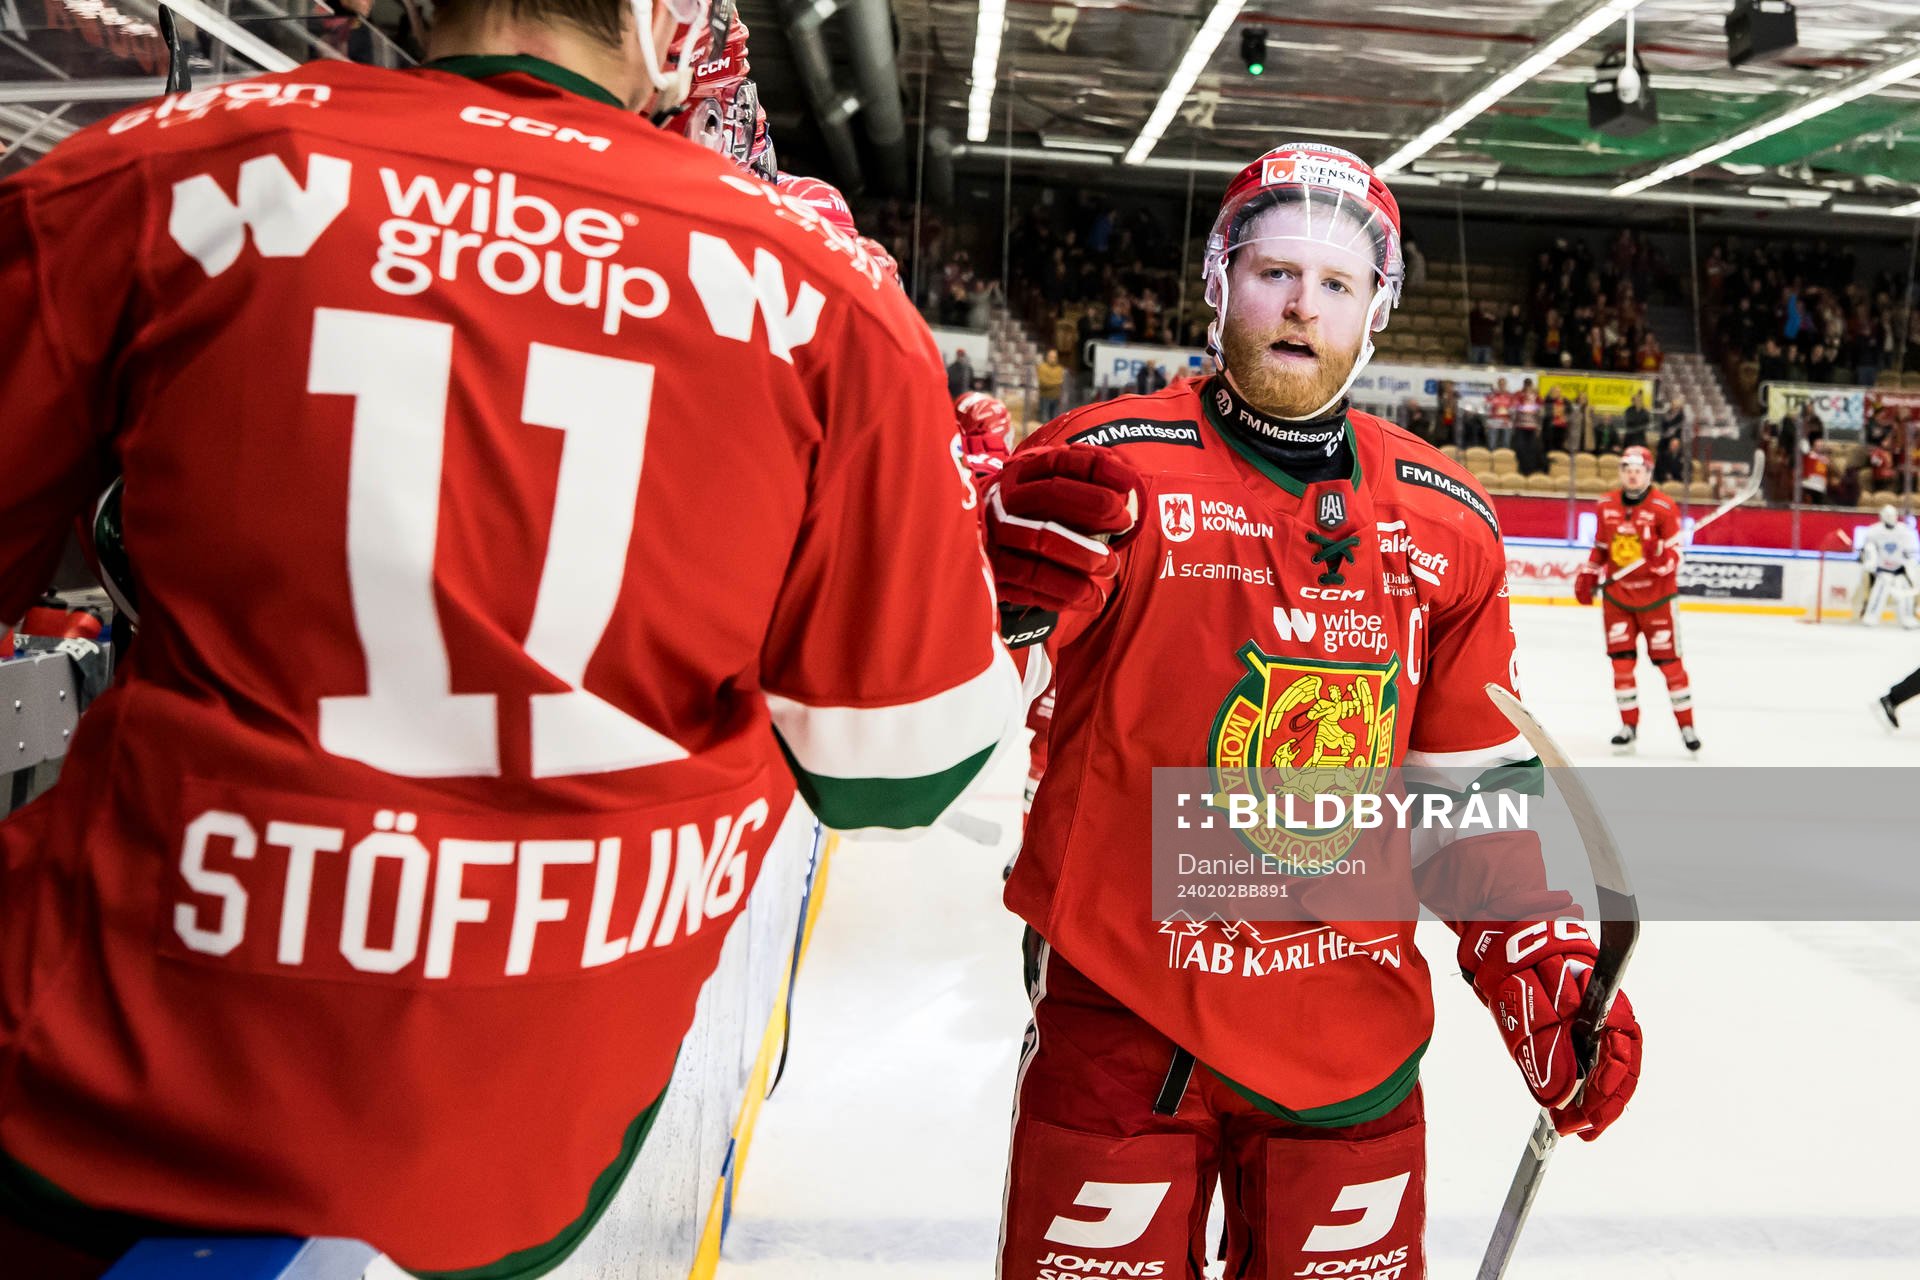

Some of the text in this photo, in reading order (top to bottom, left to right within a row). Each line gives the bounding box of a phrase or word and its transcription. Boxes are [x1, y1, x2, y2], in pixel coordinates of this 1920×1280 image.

[697, 56, 731, 77] CCM
[459, 106, 612, 152] CCM
[1300, 165, 1366, 188] SVENSKA
[379, 167, 624, 258] wibe
[370, 218, 671, 336] group
[1108, 423, 1198, 441] Mattsson
[1239, 409, 1261, 431] FM
[1261, 422, 1332, 443] Mattsson
[1200, 500, 1247, 521] MORA
[1401, 465, 1499, 533] FM Mattsson
[307, 307, 691, 779] 11
[1179, 563, 1275, 586] scanmast
[1300, 587, 1365, 601] CCM
[1322, 609, 1382, 632] wibe
[1323, 630, 1388, 655] group
[1407, 607, 1422, 685] C
[1221, 712, 1251, 791] MORA
[173, 797, 769, 979] STÖFFLING
[1183, 940, 1235, 974] AB
[1242, 944, 1315, 977] KARL
[1036, 1252, 1166, 1277] JOHNS
[1293, 1245, 1409, 1276] JOHNS
